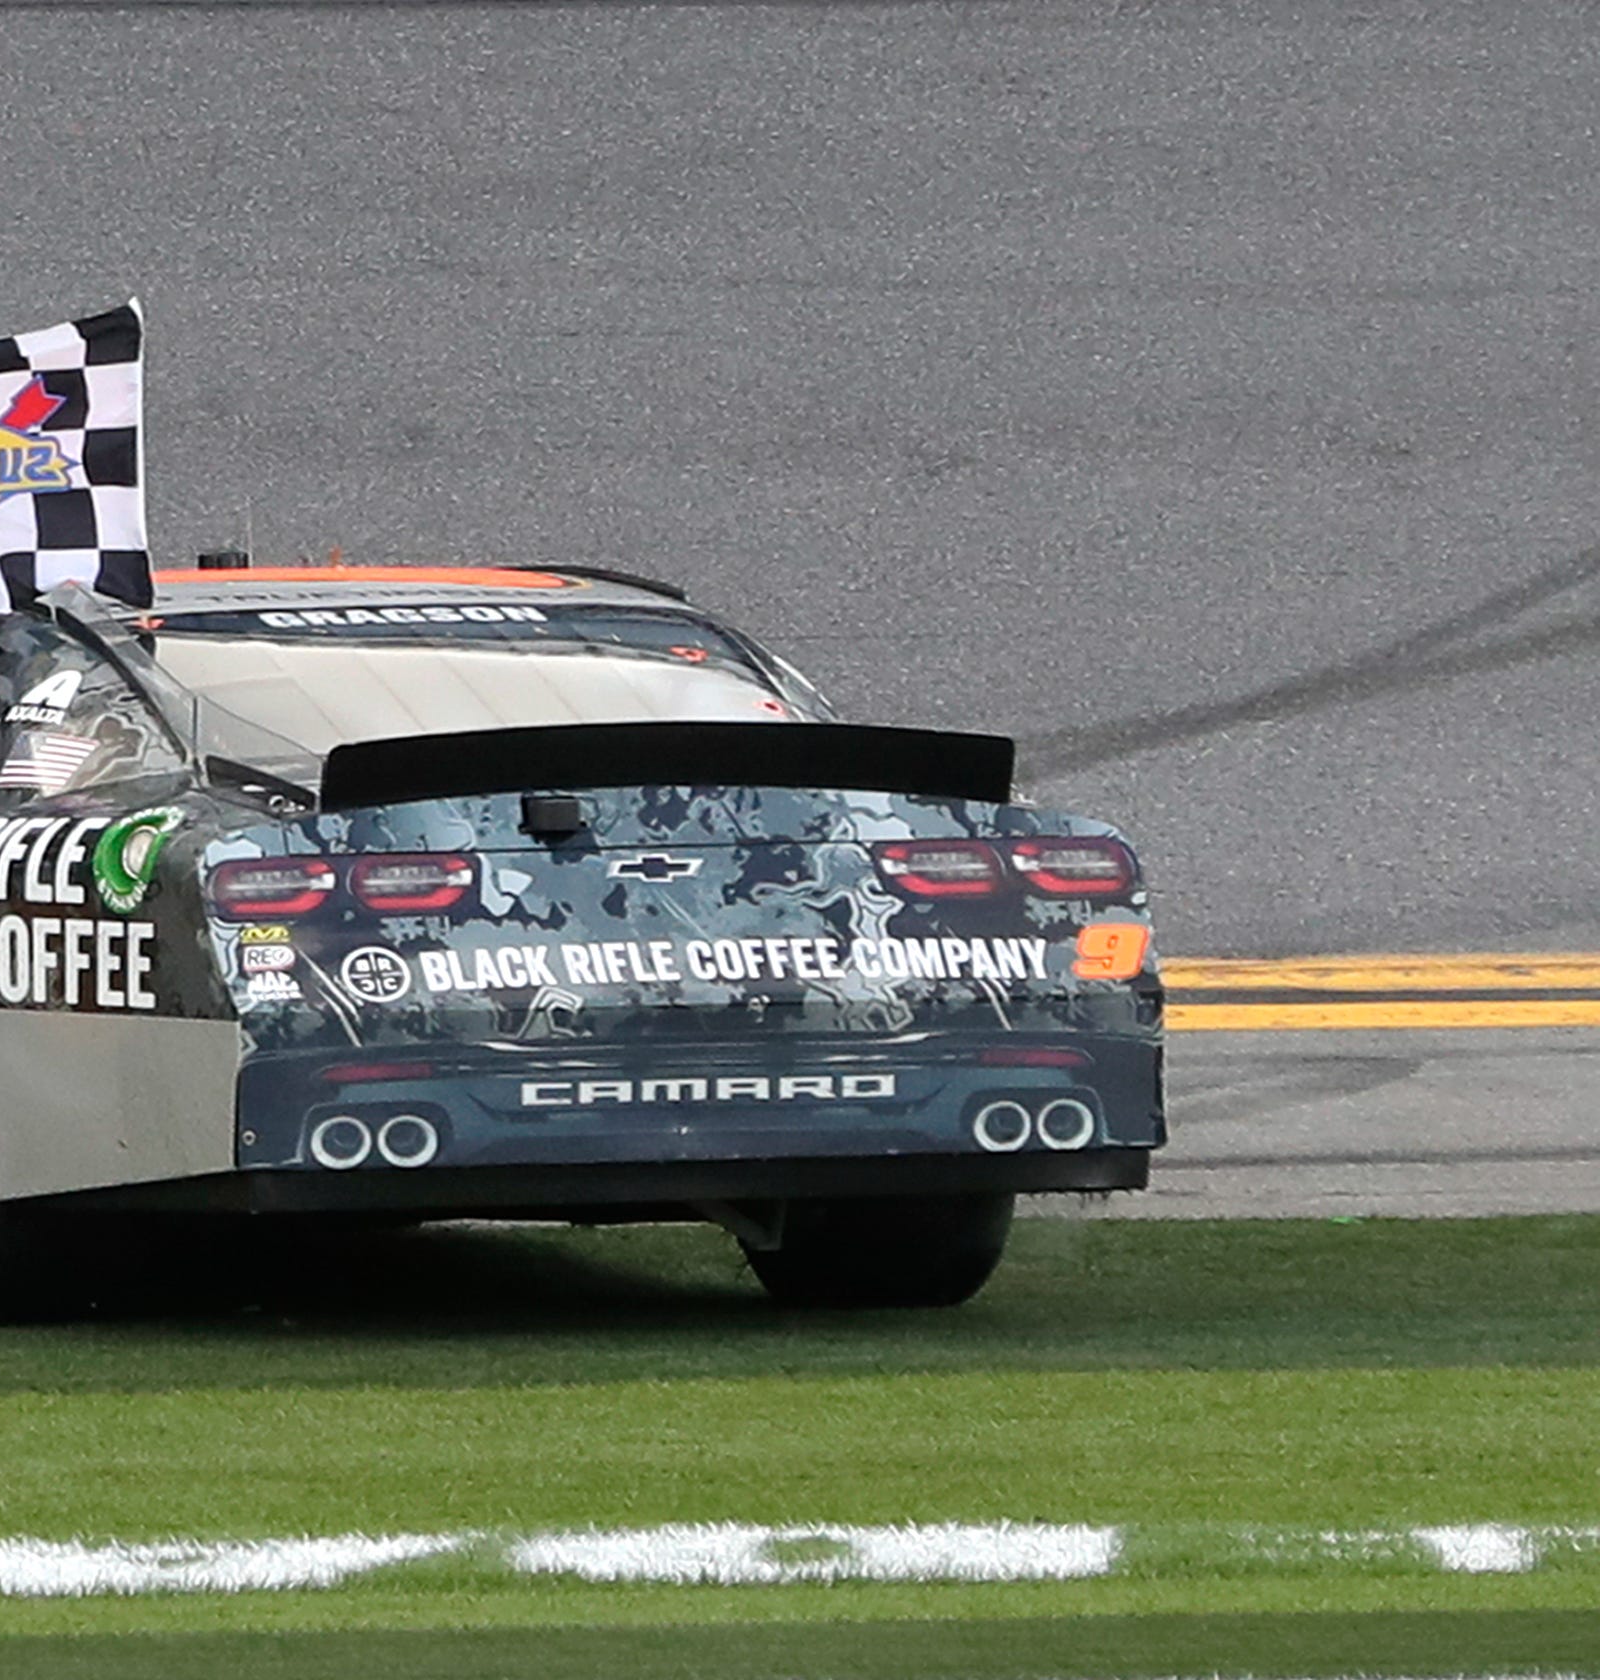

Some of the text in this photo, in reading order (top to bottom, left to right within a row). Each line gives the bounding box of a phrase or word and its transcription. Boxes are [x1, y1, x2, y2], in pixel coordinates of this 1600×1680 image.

[258, 606, 549, 628] GRAGSON
[4, 704, 66, 726] AXALTA
[419, 937, 1049, 993] BLACK RIFLE COFFEE COMPANY
[1071, 923, 1149, 982] 9
[521, 1074, 896, 1107] CAMARO
